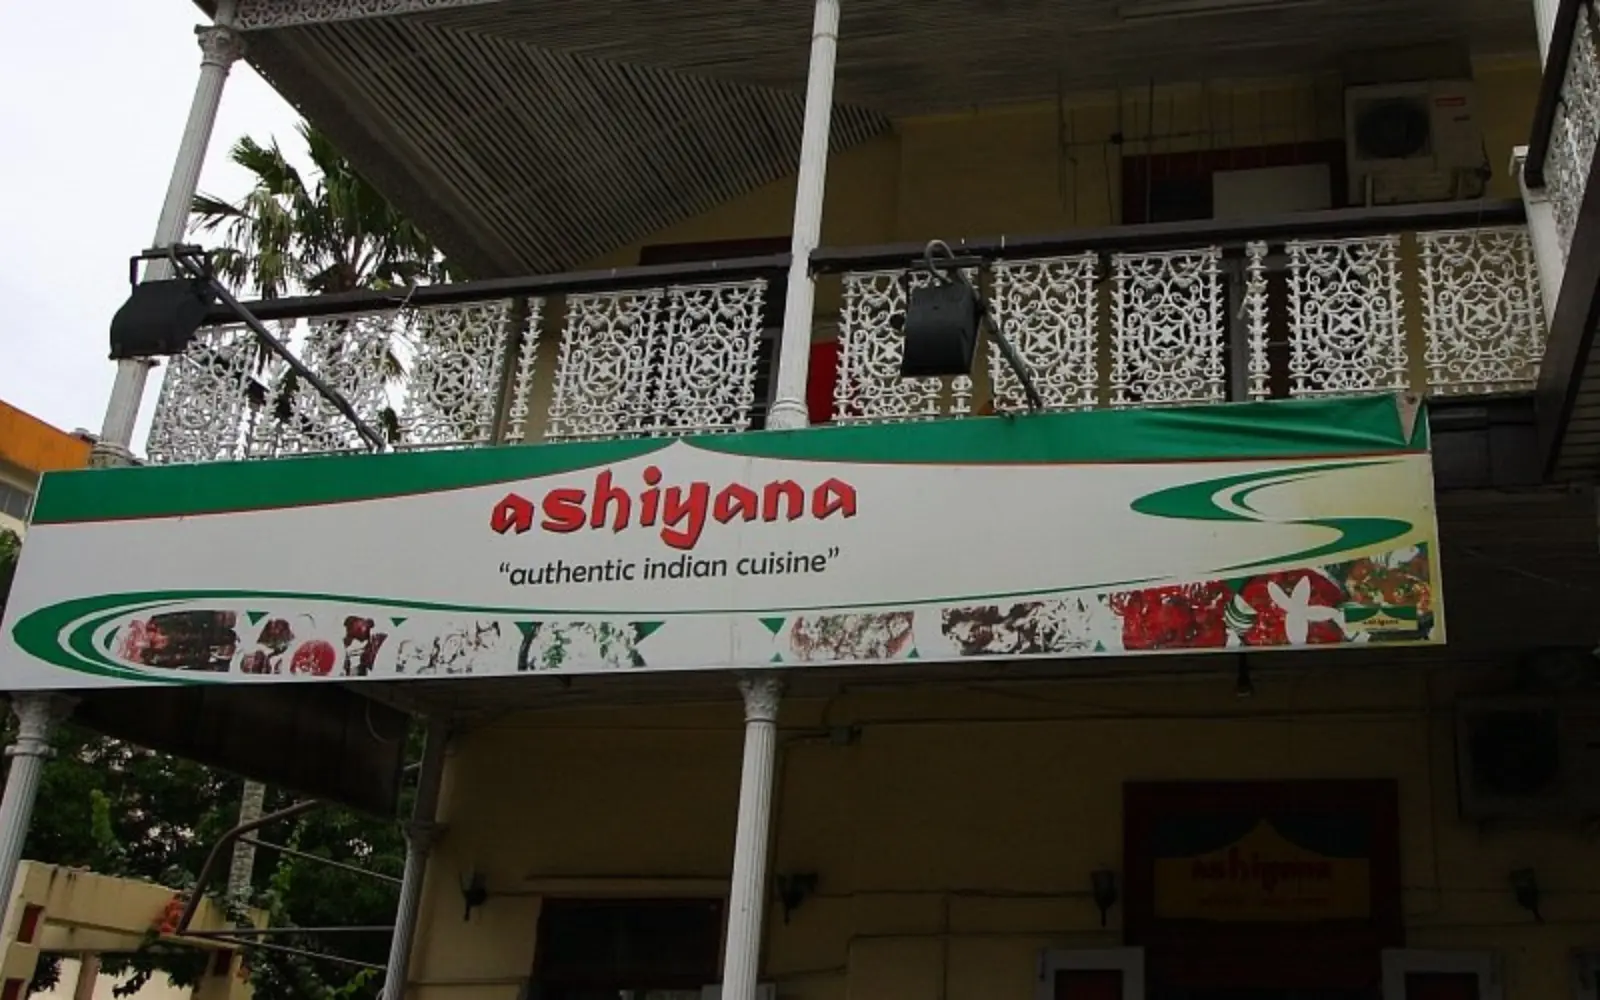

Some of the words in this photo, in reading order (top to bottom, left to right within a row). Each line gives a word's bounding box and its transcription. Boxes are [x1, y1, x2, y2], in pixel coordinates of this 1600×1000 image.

[490, 466, 858, 551] ashiyana
[499, 560, 636, 586] “authentic
[643, 555, 728, 580] indian
[736, 547, 840, 577] cuisine”
